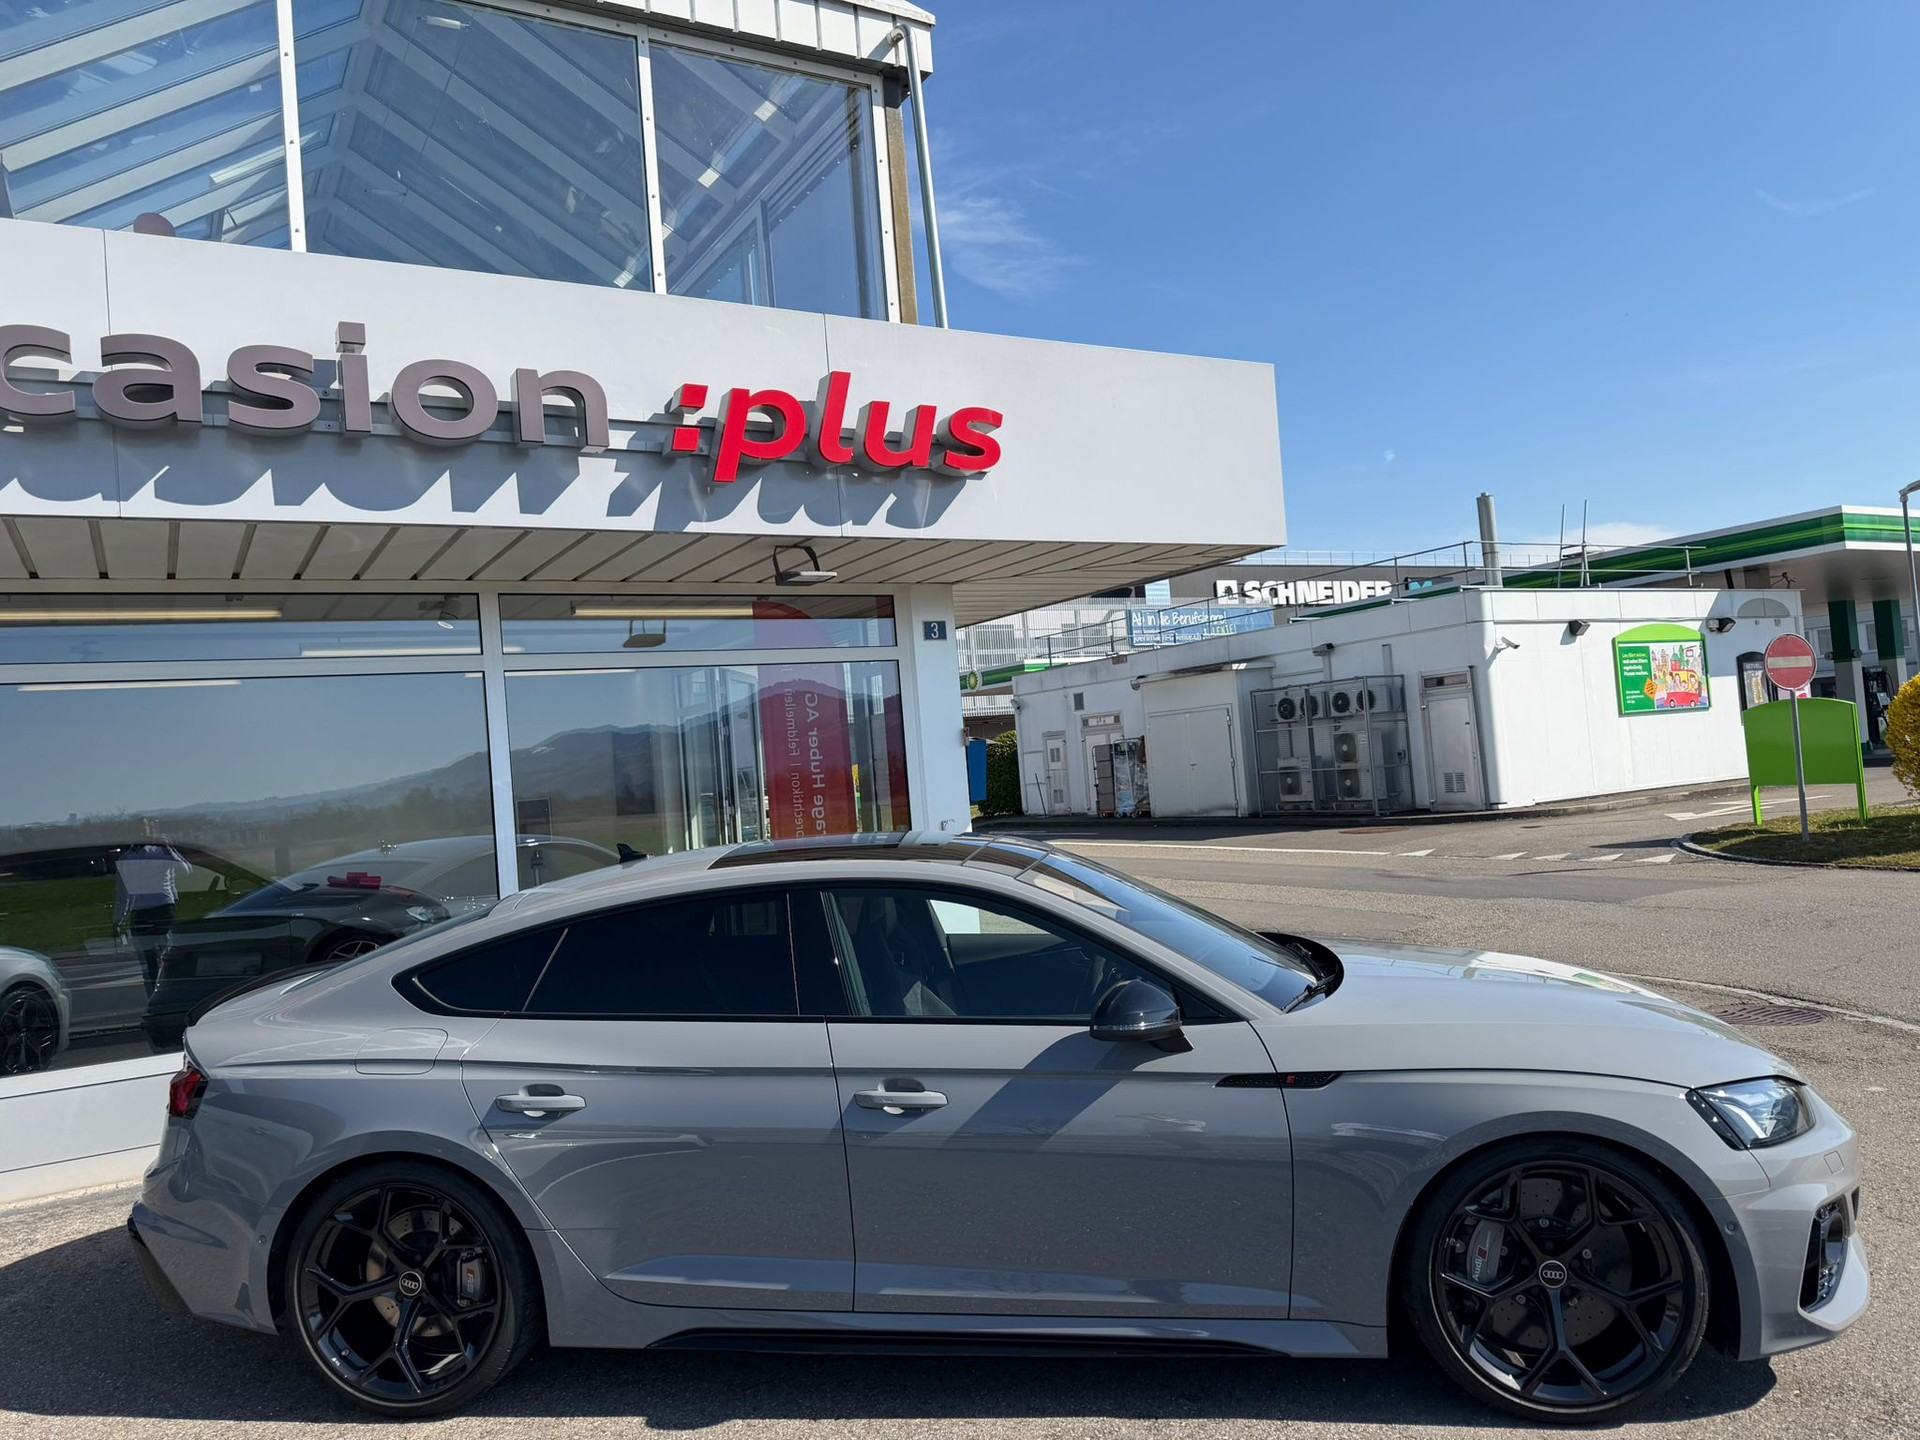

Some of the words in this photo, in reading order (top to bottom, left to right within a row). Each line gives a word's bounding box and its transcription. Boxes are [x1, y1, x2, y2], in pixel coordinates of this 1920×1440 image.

[0, 321, 610, 453] casion
[1244, 579, 1393, 605] SCHNEIDER
[930, 622, 939, 639] 3
[1472, 1258, 1483, 1281] Audi
